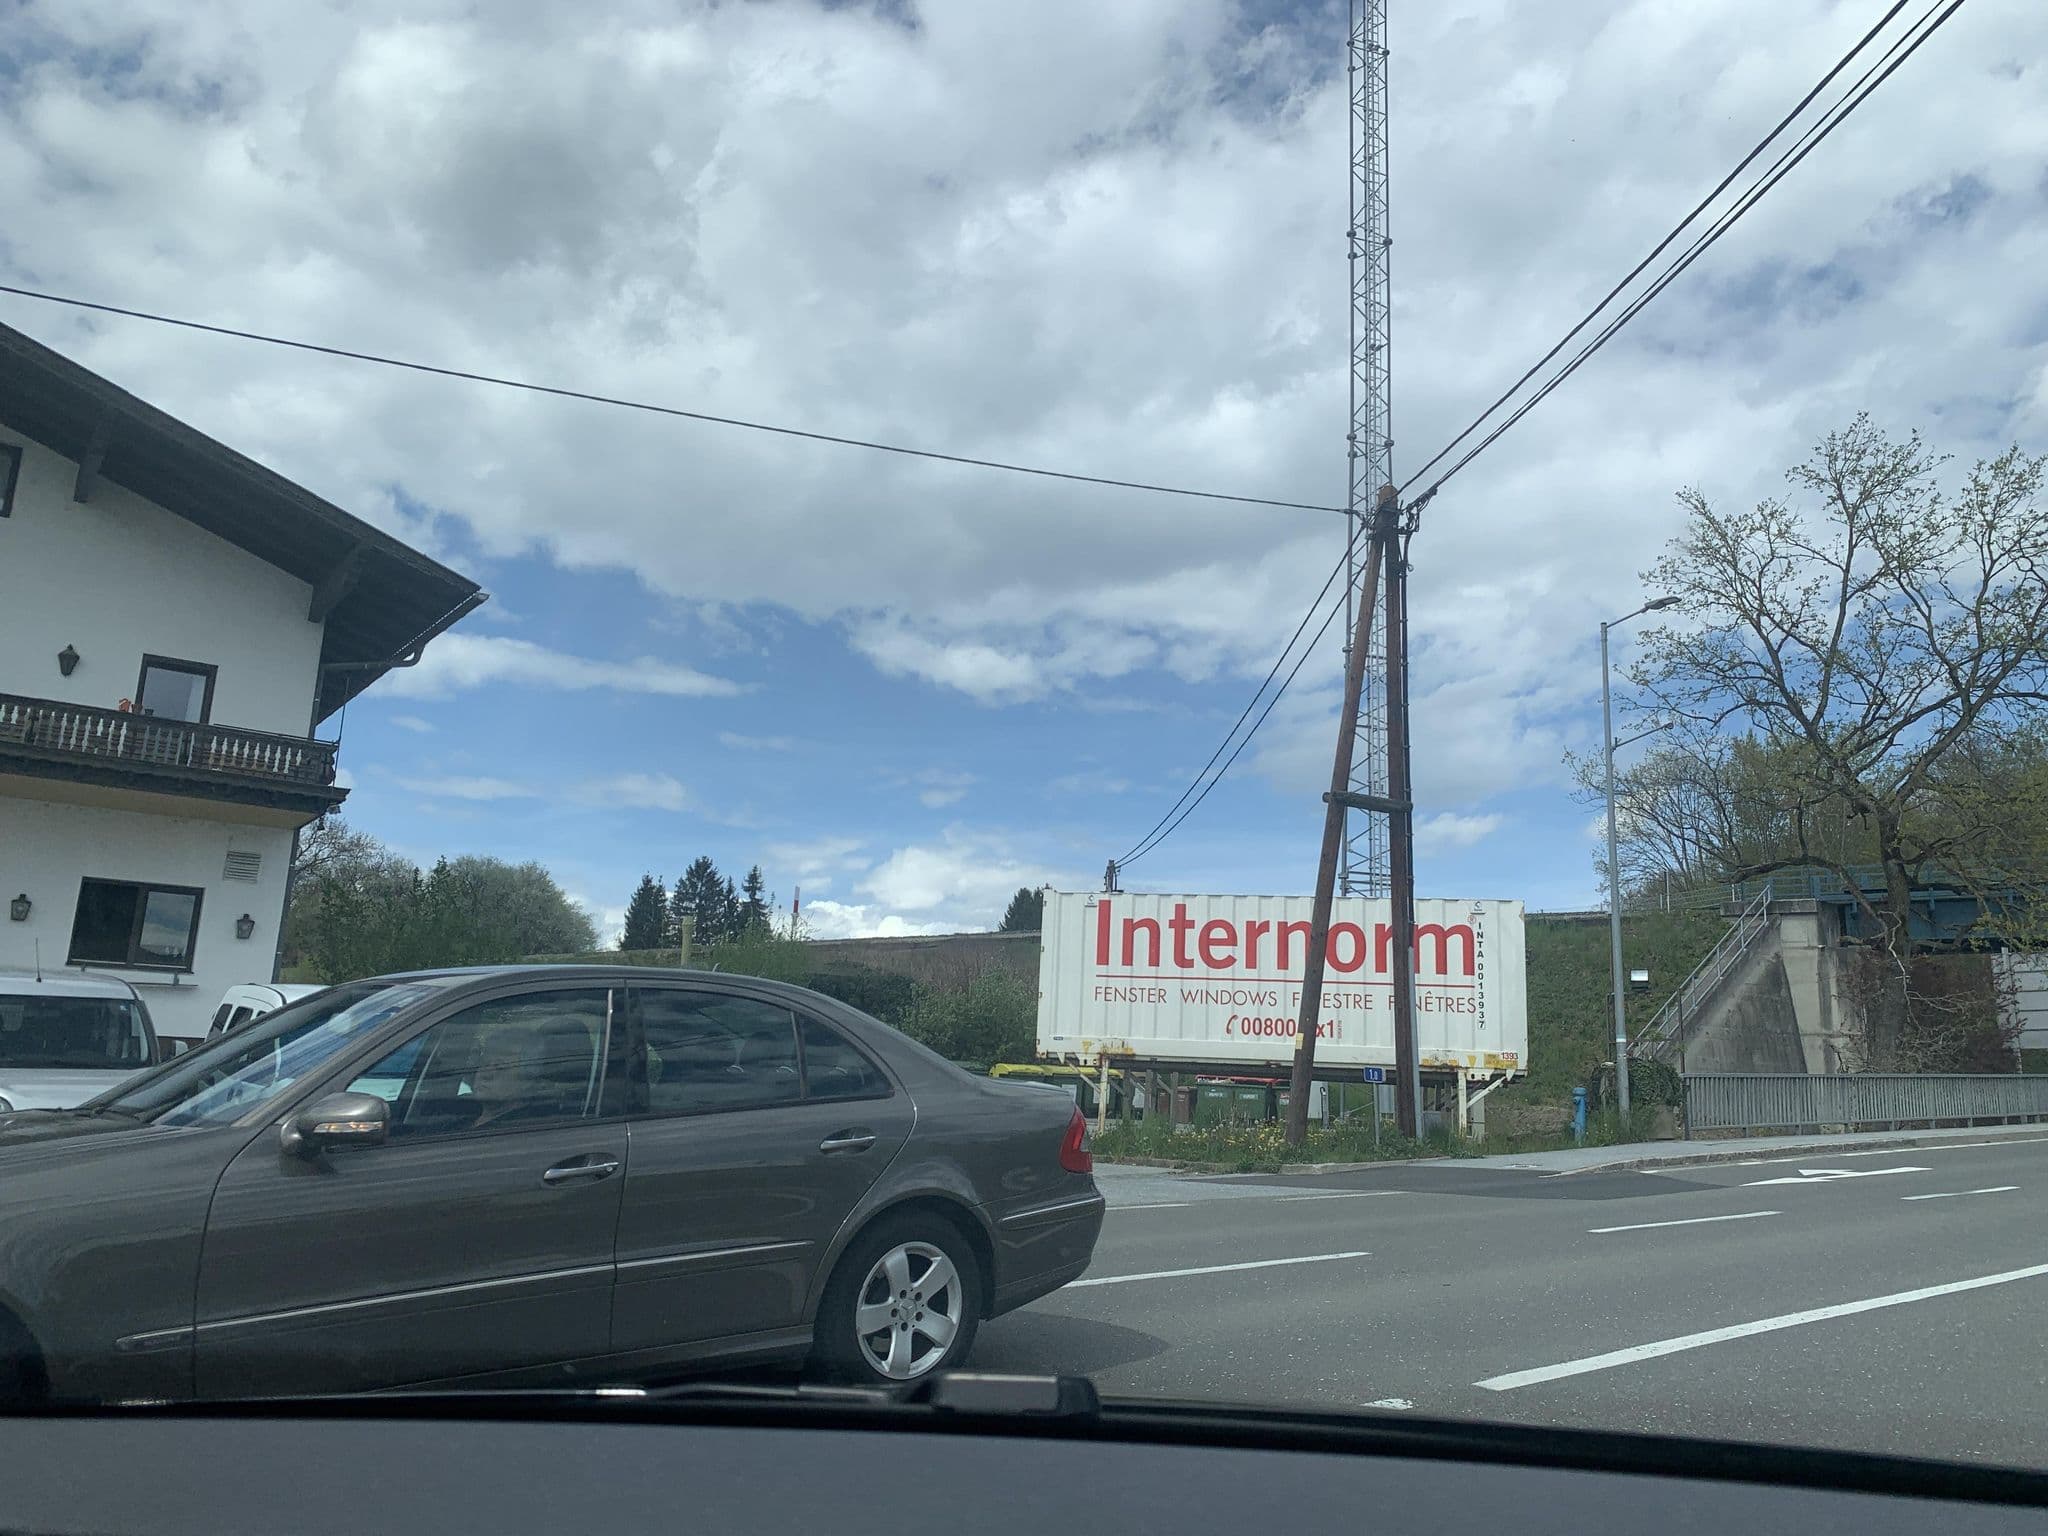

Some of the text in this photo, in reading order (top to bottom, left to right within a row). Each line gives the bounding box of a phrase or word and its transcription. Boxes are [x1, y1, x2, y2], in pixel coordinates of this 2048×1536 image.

[1096, 900, 1475, 976] Internorm
[1095, 986, 1476, 1014] FENSTER WINDOWS FESTRE FNÊTRES
[1241, 1017, 1296, 1036] 00800
